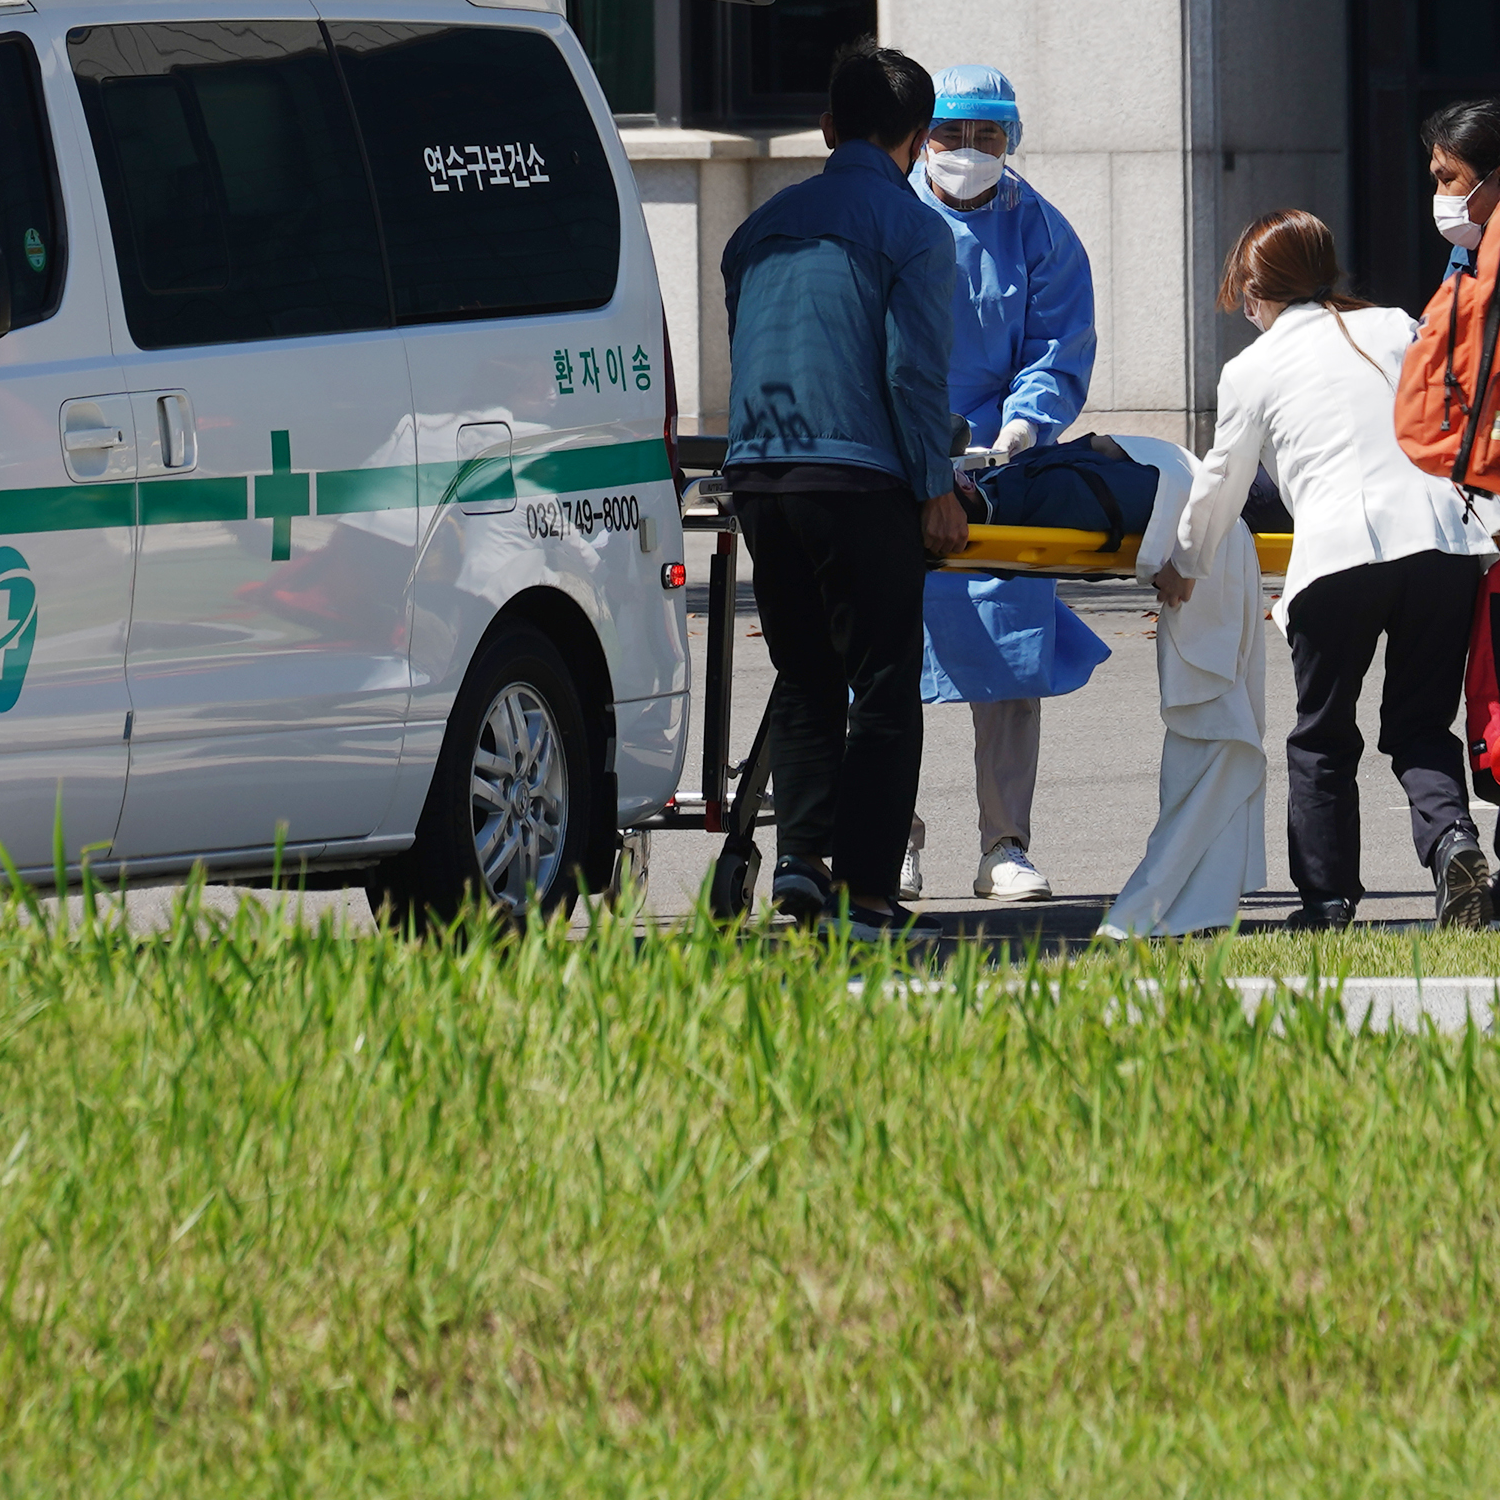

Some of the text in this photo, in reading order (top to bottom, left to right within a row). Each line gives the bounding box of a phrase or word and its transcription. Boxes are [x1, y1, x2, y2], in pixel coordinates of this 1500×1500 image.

[423, 141, 550, 192] 연수구보건소
[553, 344, 651, 395] 환자이송
[526, 495, 640, 540] 032)749-8000
